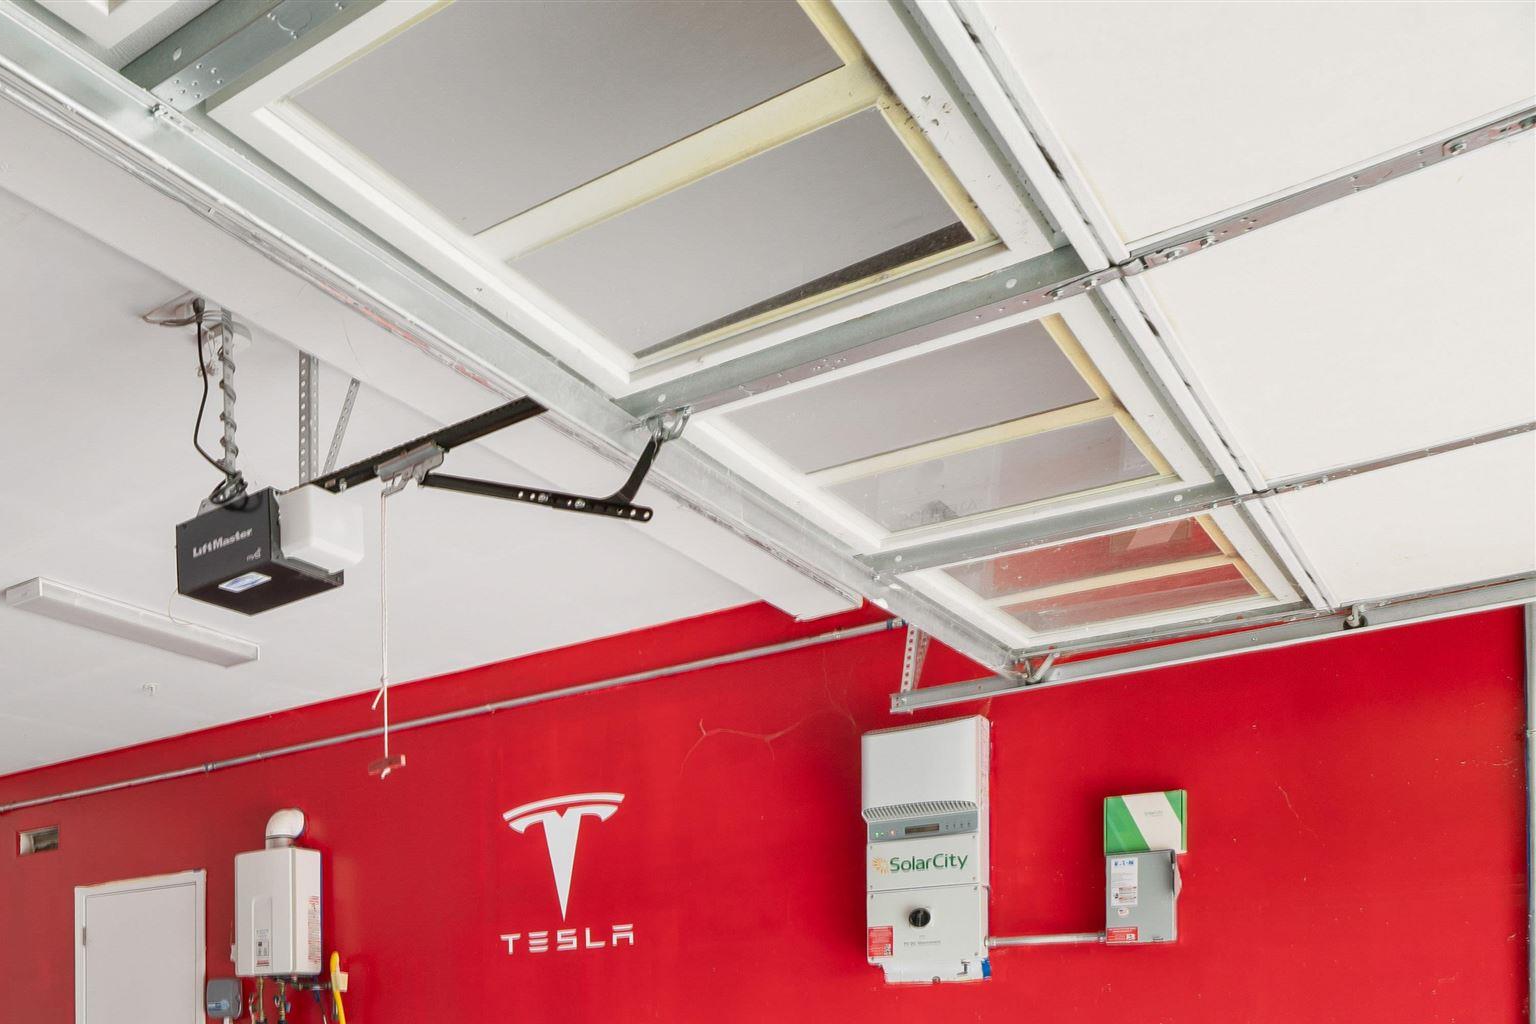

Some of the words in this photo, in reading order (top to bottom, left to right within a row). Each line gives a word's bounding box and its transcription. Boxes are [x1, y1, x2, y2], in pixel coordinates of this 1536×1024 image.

[193, 528, 252, 558] LiftMaster
[890, 853, 968, 872] SolarCity
[500, 923, 634, 955] TESLA
